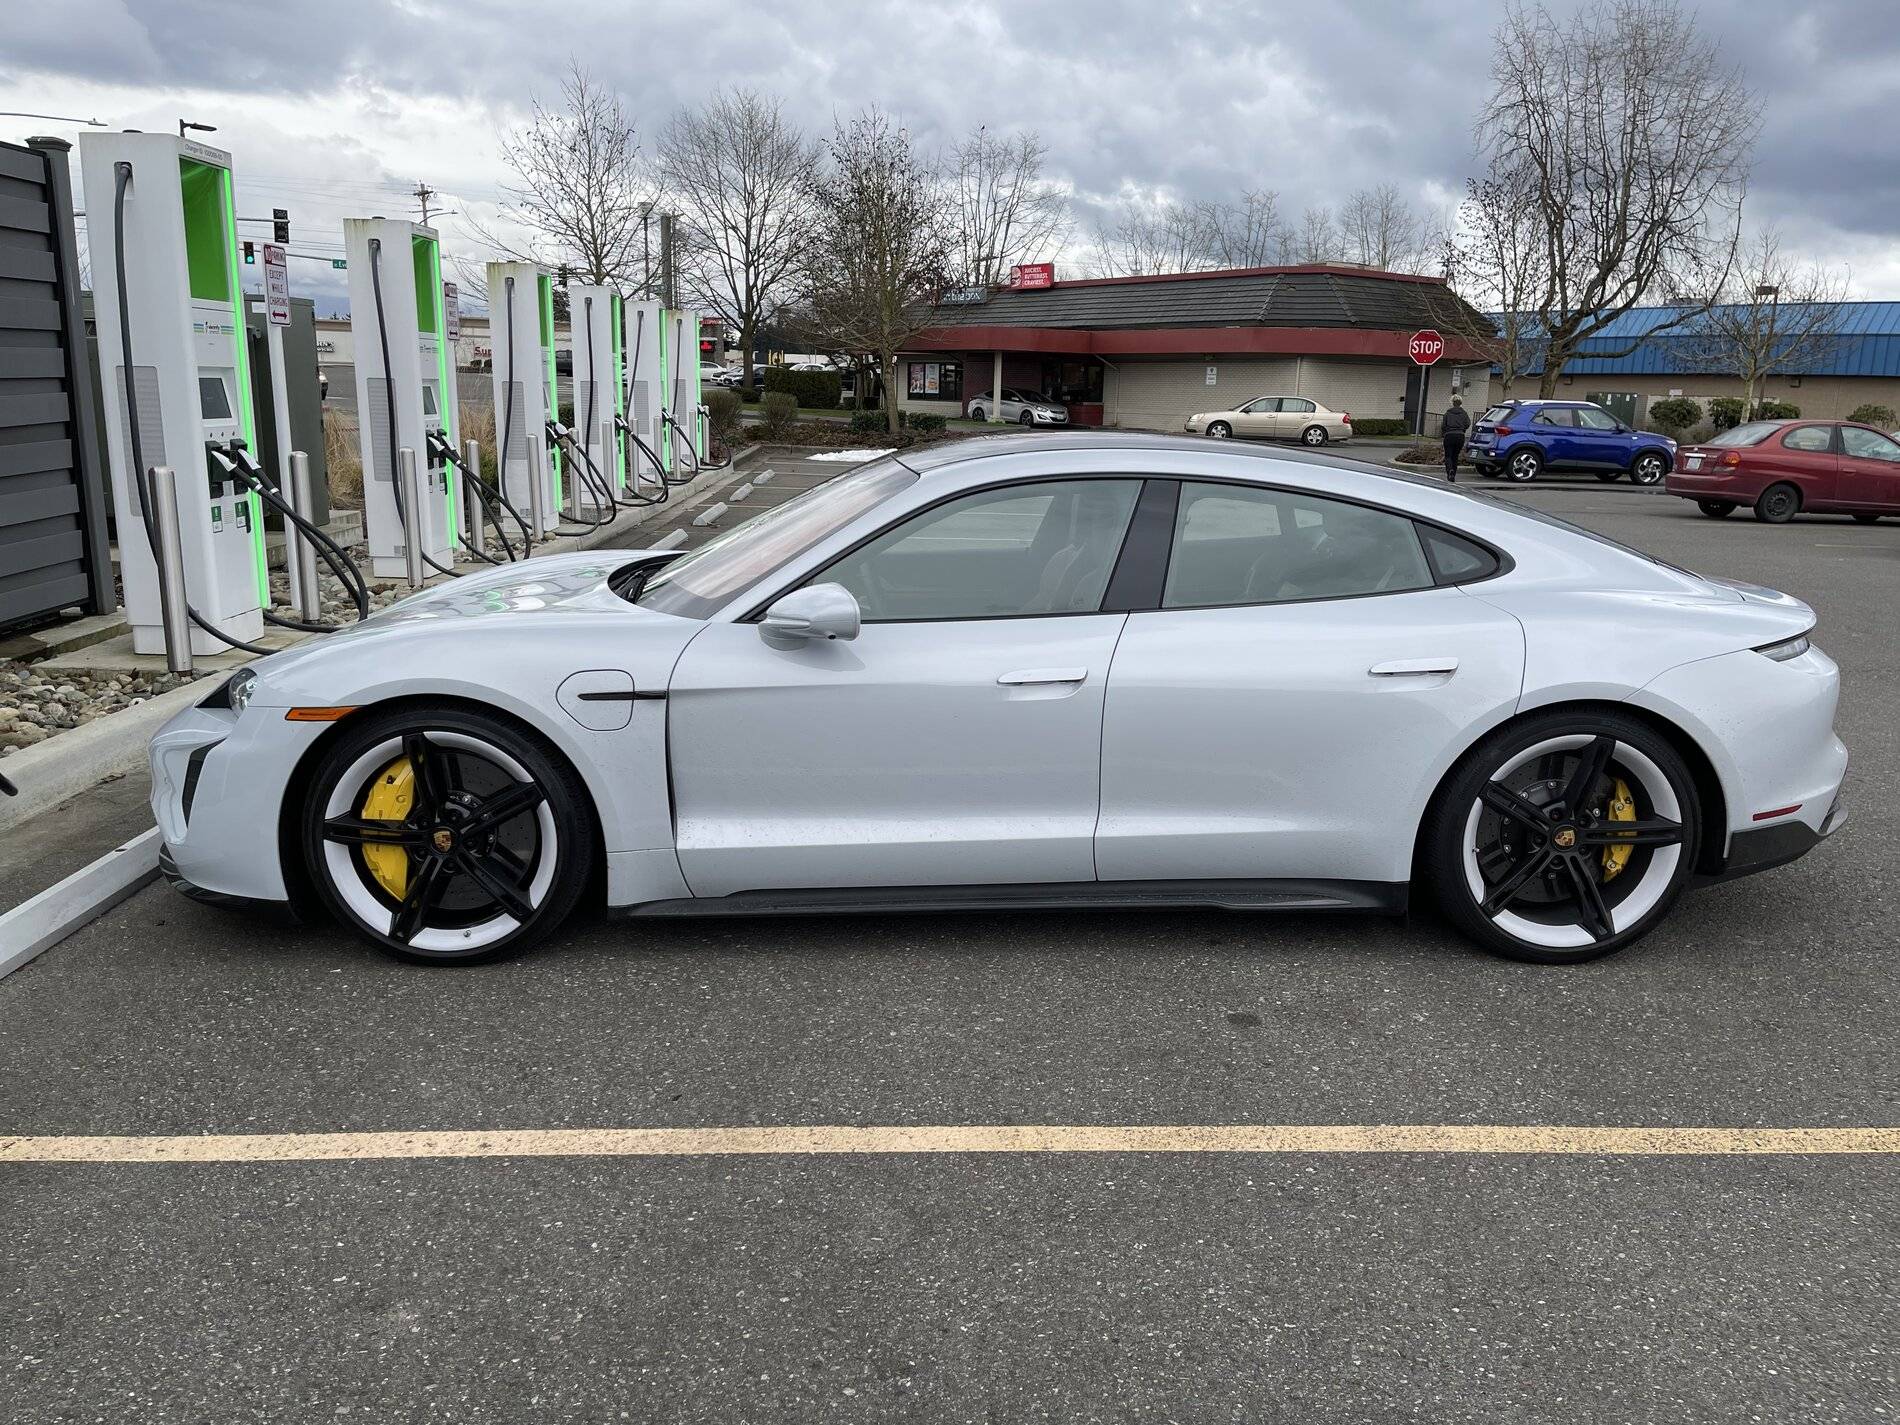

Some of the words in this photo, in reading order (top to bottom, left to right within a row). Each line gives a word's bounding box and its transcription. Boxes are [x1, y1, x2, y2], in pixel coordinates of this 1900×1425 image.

[269, 270, 284, 280] EXCEPT
[272, 283, 284, 294] WHILE
[1412, 340, 1441, 354] STOP
